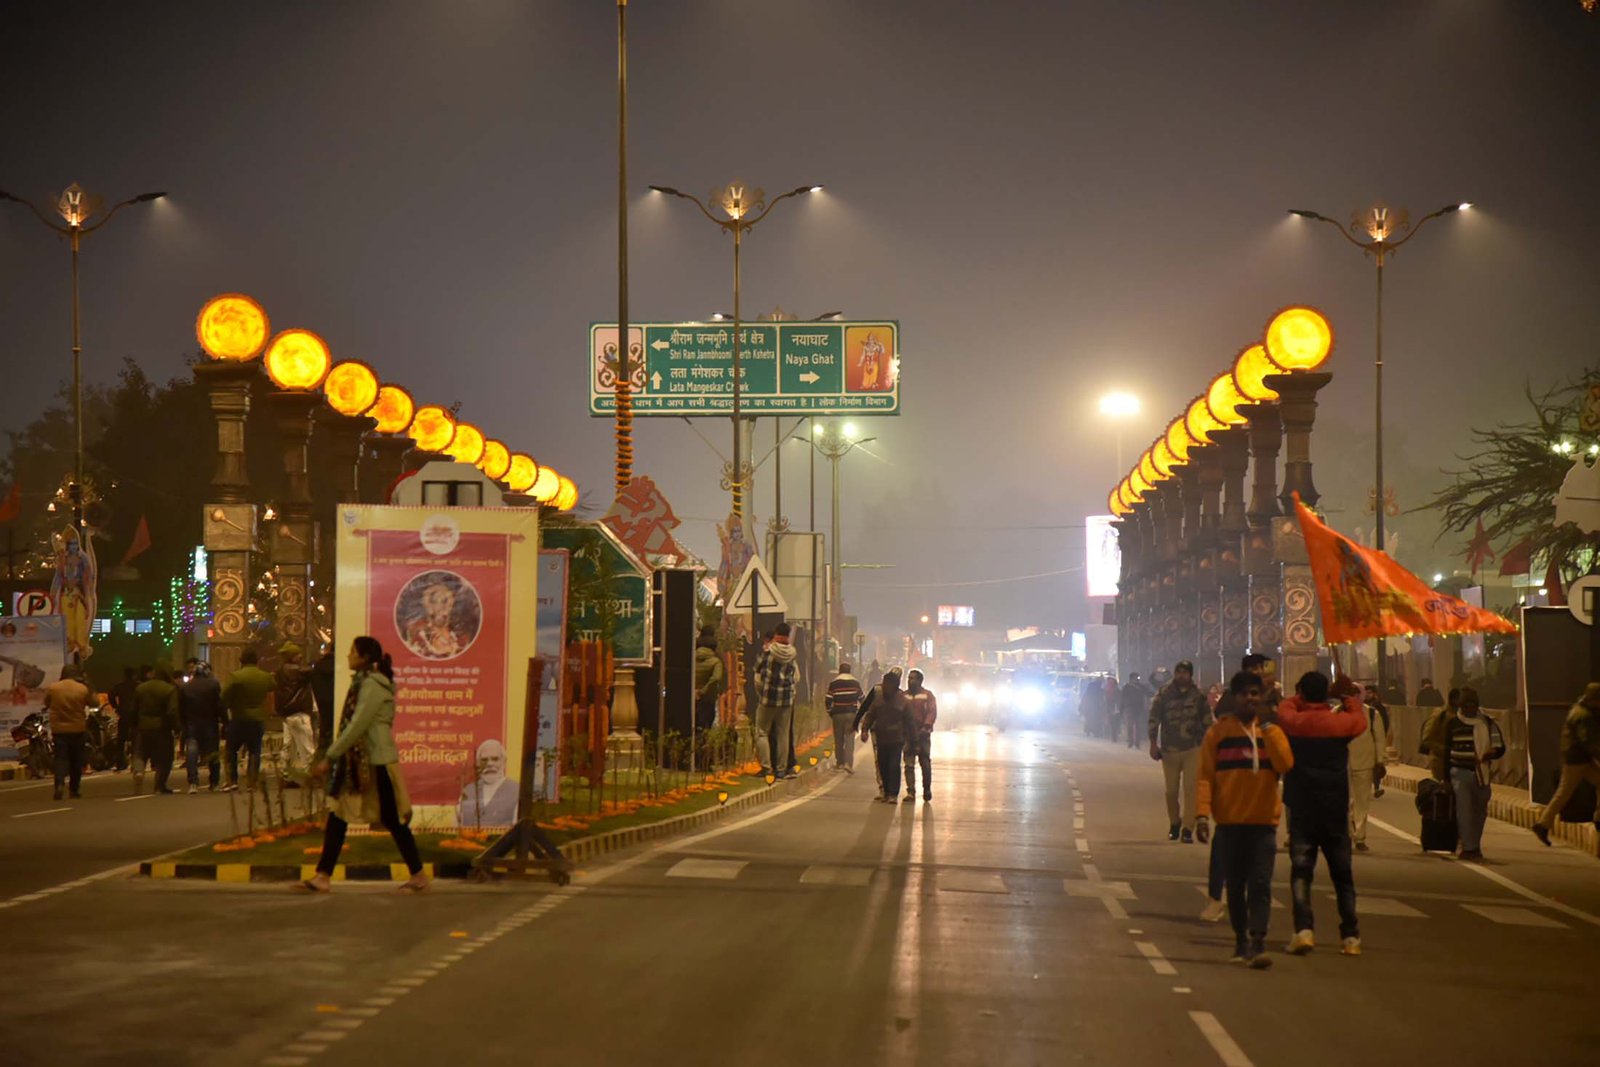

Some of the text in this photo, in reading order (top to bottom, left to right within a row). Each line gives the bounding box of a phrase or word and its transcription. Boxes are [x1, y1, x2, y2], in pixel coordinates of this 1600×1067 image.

[671, 329, 693, 345] श्रीराम
[791, 334, 830, 346] नयाघाट
[669, 349, 681, 360] Shri
[683, 349, 695, 360] Ram
[785, 353, 834, 366] Naya Ghat
[670, 367, 688, 379] लता
[691, 363, 724, 379] मंगेशकर
[669, 382, 685, 392] Lata
[667, 398, 684, 408] आप
[688, 397, 706, 407] सभी
[770, 398, 796, 407] स्वागत
[398, 744, 469, 767] अभिनंदन
